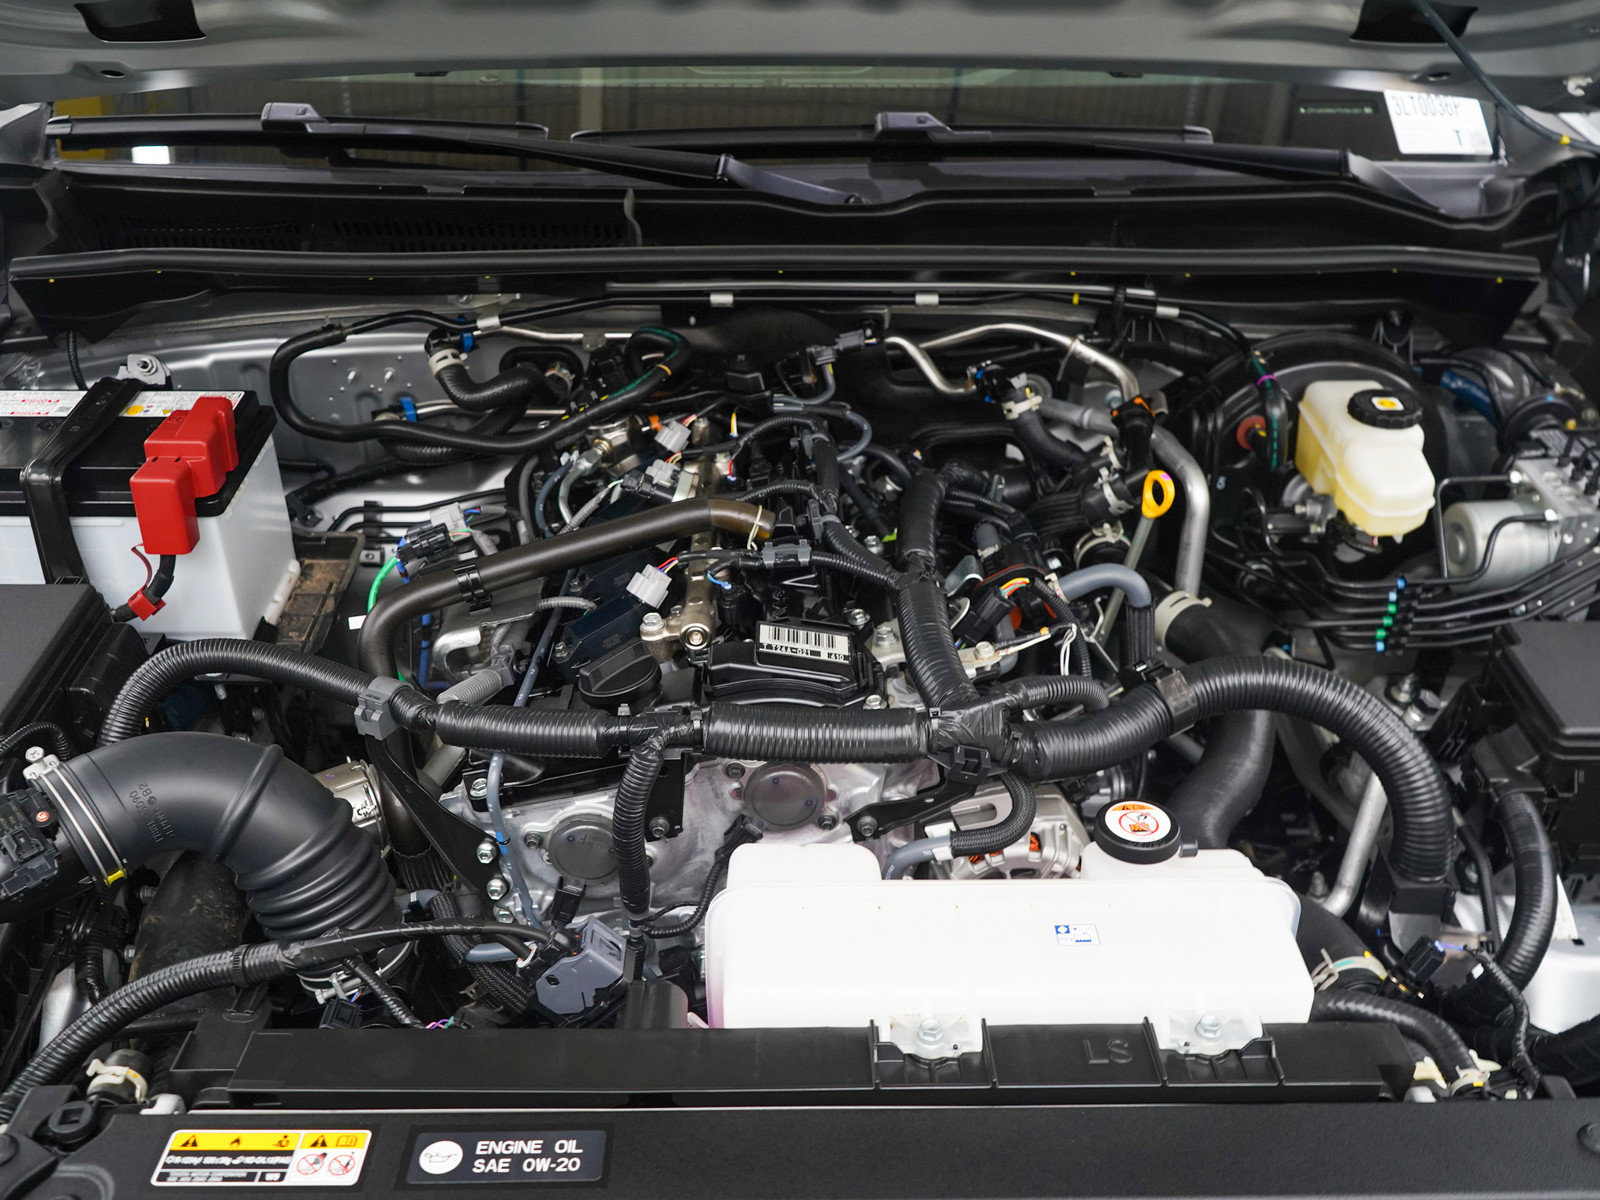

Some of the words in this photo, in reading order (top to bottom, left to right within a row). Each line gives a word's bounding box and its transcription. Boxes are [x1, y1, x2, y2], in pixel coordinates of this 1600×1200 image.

[1452, 129, 1463, 146] T
[1083, 1039, 1134, 1064] LS
[475, 1140, 543, 1155] ENGINE
[554, 1139, 584, 1154] OIL
[472, 1157, 511, 1173] SAE
[522, 1157, 581, 1172] 0W-20
